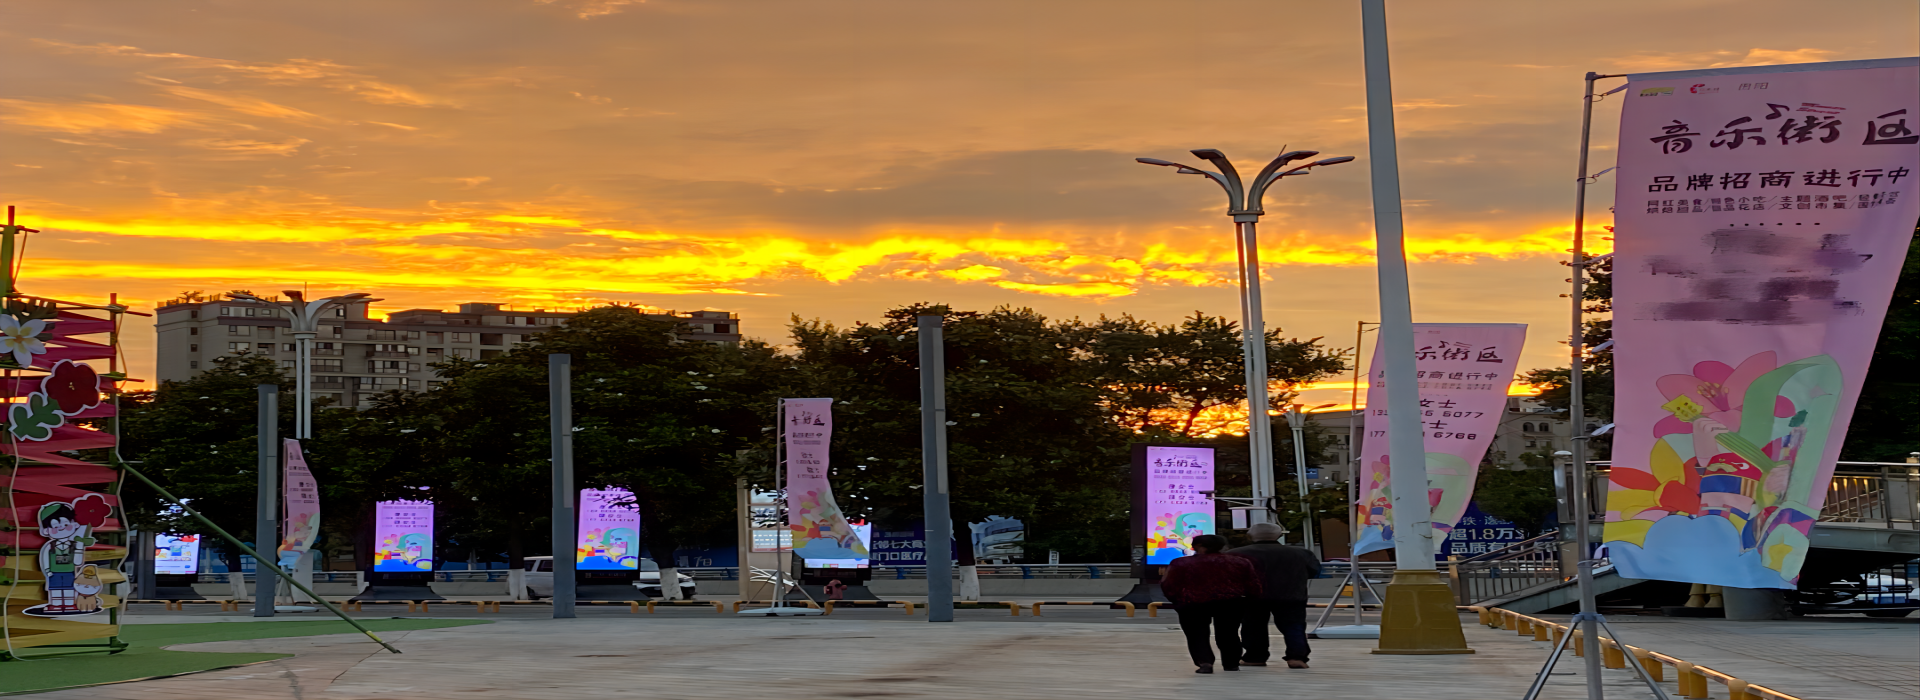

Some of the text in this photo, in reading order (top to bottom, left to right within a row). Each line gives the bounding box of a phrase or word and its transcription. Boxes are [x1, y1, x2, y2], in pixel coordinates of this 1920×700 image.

[1650, 109, 1920, 154] 音乐街区
[1648, 166, 1910, 193] 品牌招商进行中
[1415, 346, 1504, 364] 乐街区
